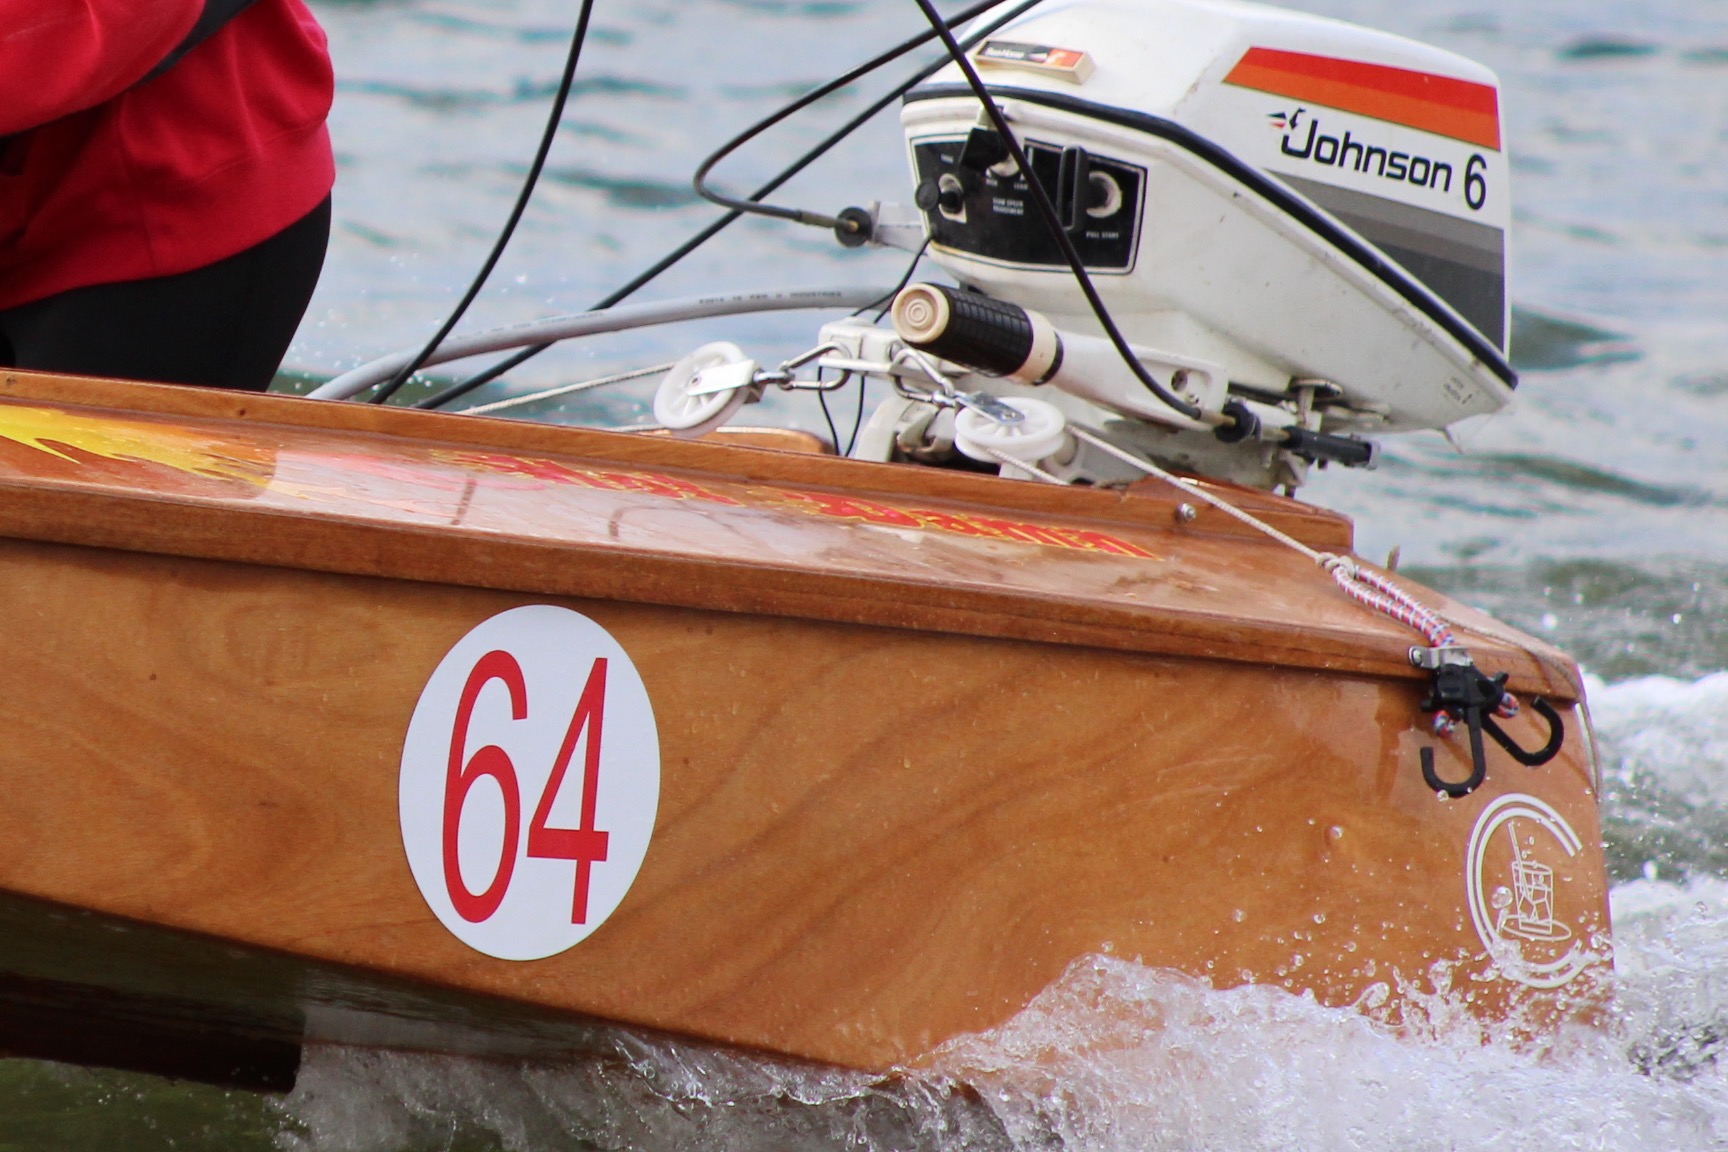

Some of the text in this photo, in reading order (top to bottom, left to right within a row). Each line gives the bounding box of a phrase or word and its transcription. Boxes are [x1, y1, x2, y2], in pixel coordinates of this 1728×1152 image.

[1281, 118, 1488, 211] Johnson 6
[443, 649, 609, 924] 64
